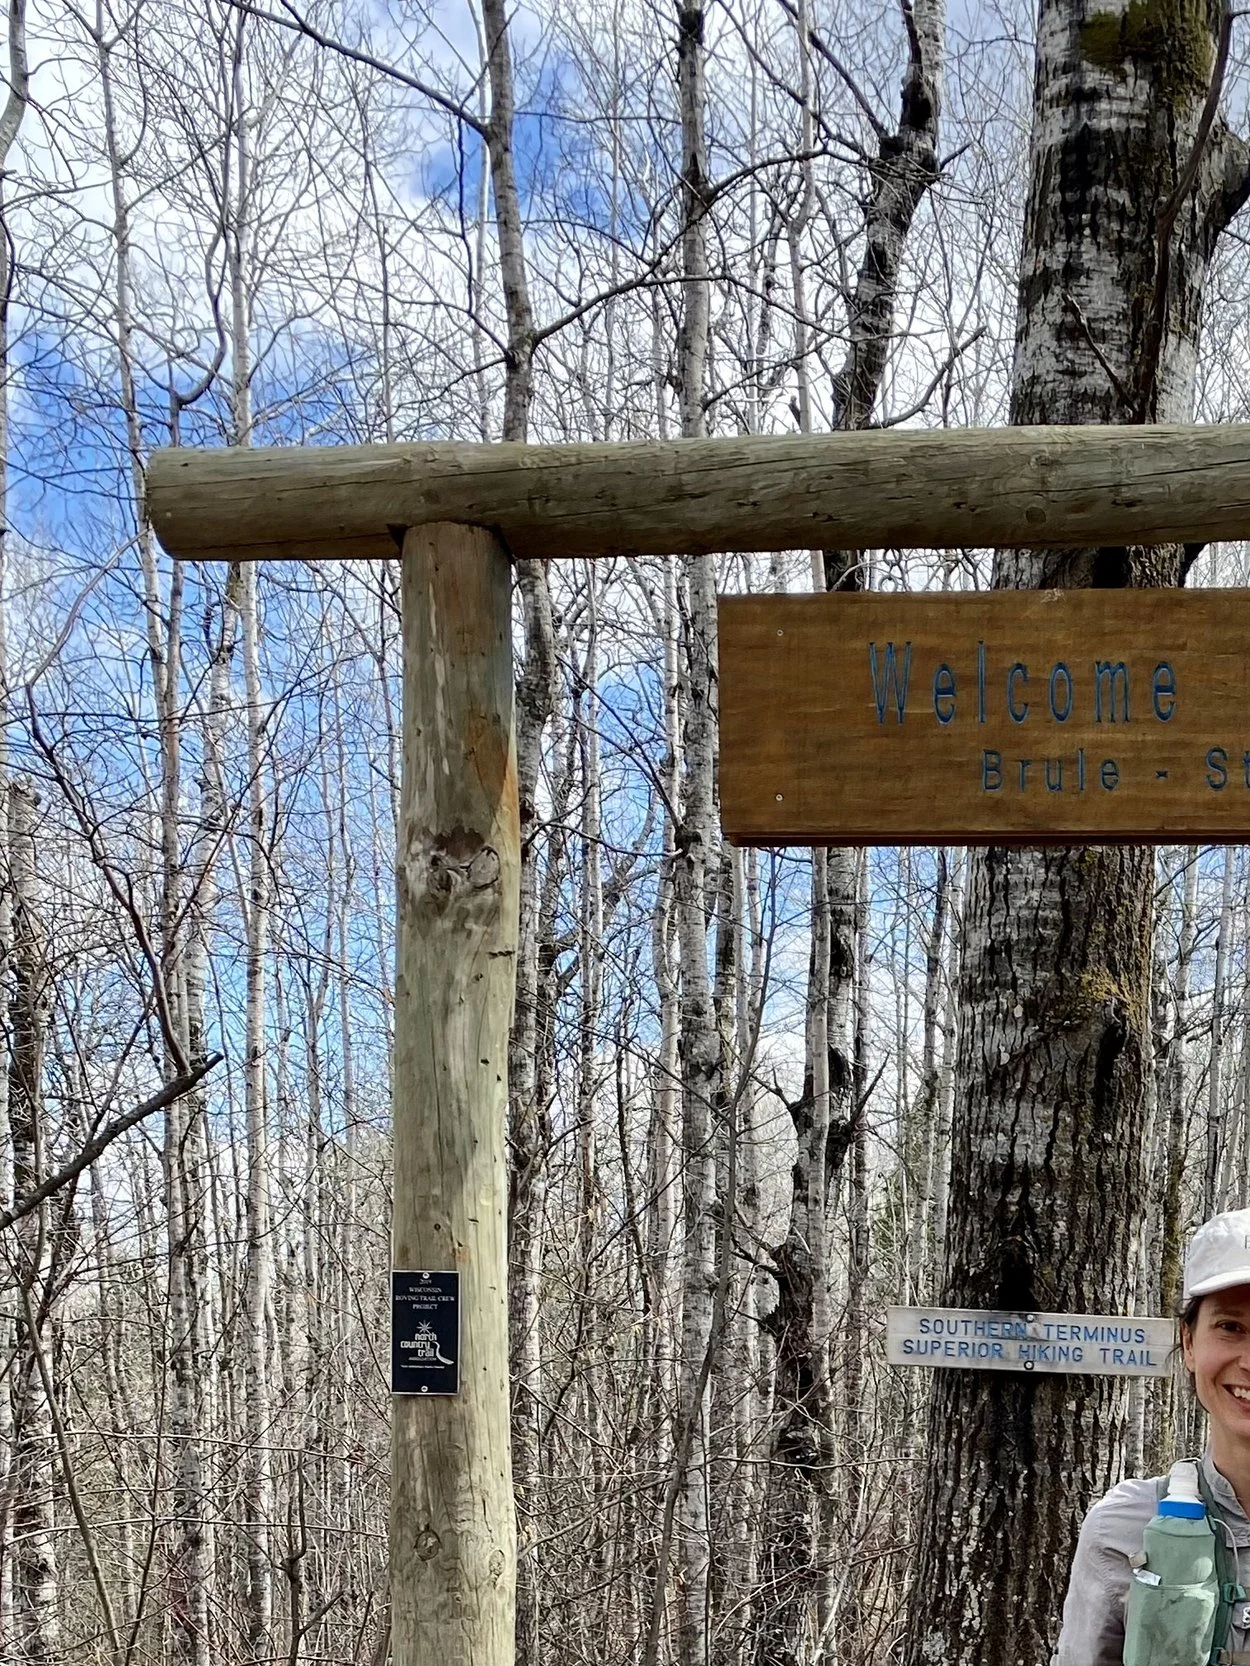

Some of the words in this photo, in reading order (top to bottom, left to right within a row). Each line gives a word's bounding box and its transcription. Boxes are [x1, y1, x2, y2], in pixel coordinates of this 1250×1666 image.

[869, 640, 1176, 725] Welcome
[981, 747, 1120, 792] Brule
[919, 1318, 1028, 1339] SOUTHERN
[1044, 1323, 1146, 1343] TERMINUS
[400, 1340, 430, 1350] country
[417, 1348, 434, 1357] trail
[902, 1339, 1003, 1358] SUPERIOR
[1018, 1344, 1084, 1362] HIKING
[1099, 1348, 1157, 1367] TRAIL
